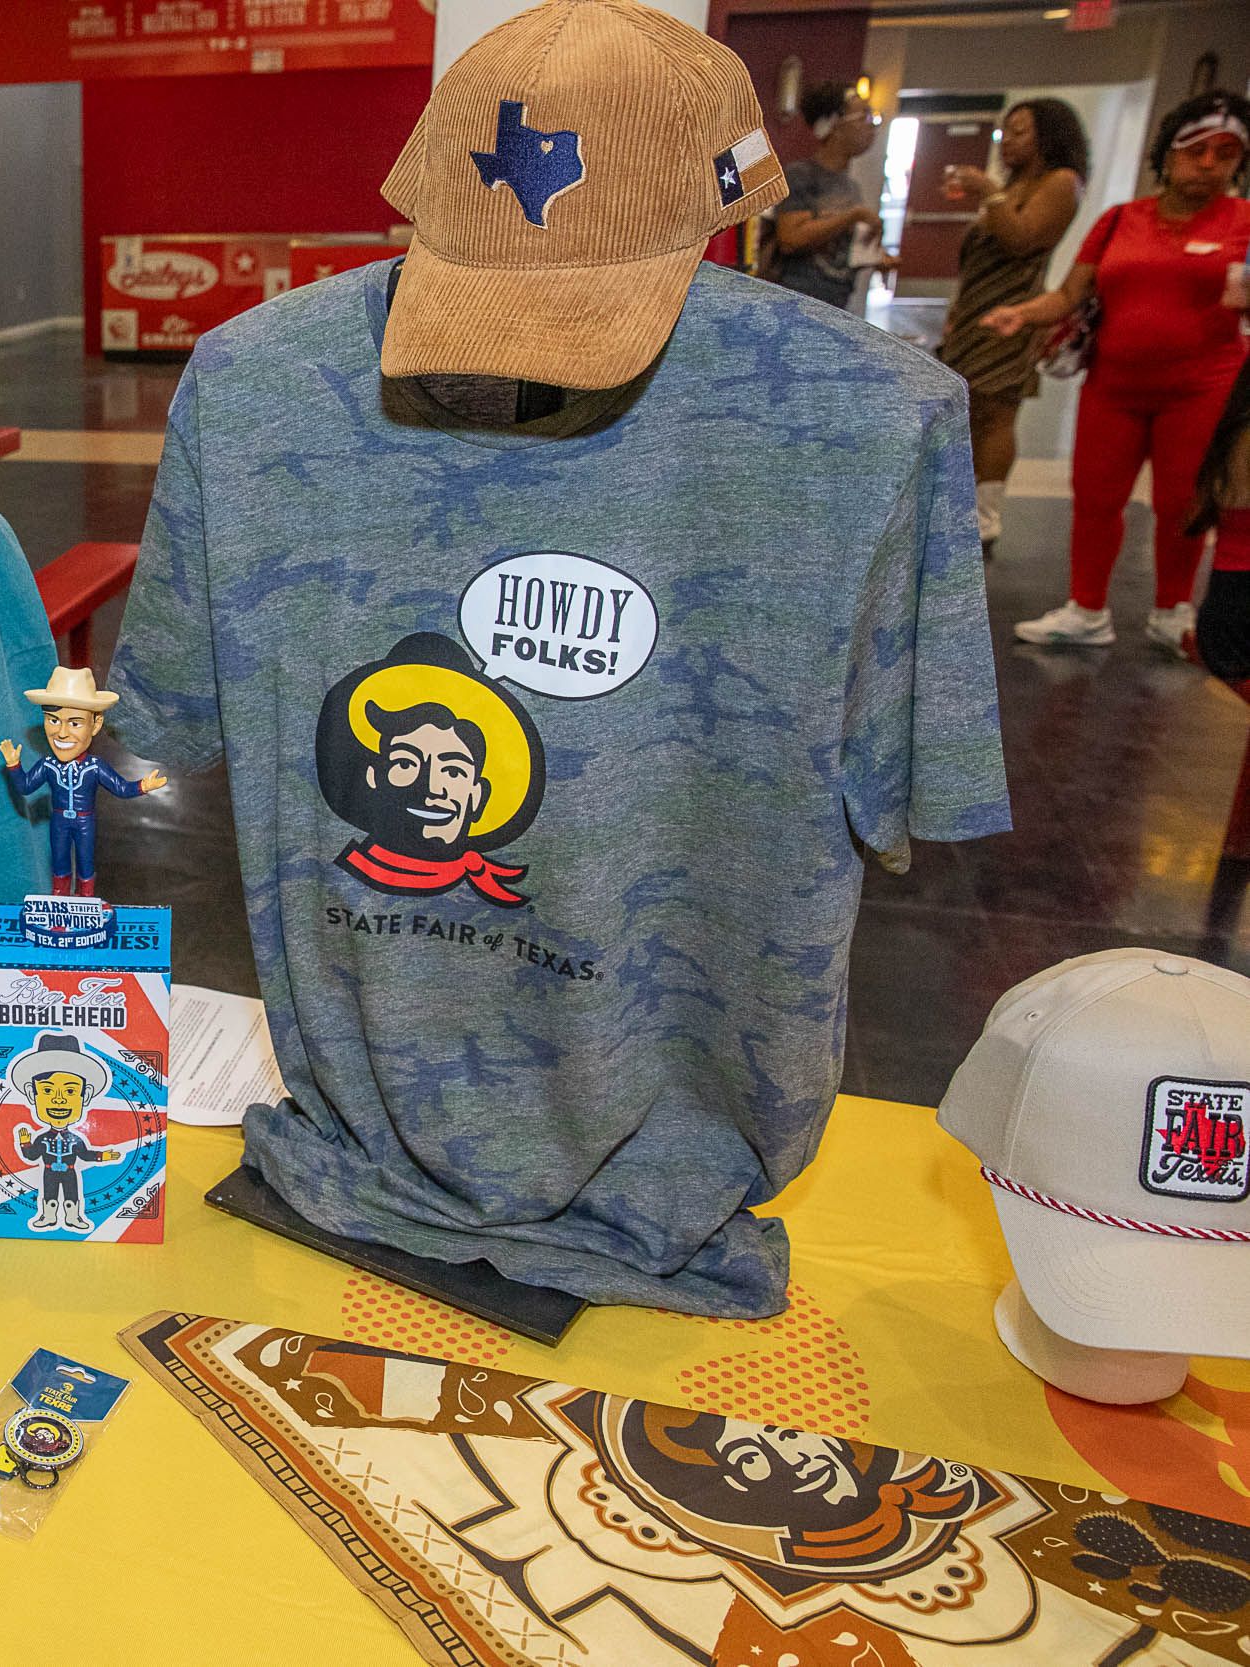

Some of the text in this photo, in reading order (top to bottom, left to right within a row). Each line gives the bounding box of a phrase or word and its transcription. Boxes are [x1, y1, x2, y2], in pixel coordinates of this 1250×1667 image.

[495, 573, 634, 643] HOWDY
[491, 632, 618, 676] FOLKS!
[48, 913, 102, 929] HOWDIES!
[326, 907, 402, 934] STATE
[411, 915, 477, 945] FAIR
[483, 932, 504, 951] of
[75, 930, 107, 947] EDITION
[70, 977, 125, 1006] Tex
[1167, 1090, 1243, 1111] STATE
[1161, 1107, 1245, 1158] FAIR
[39, 1393, 73, 1413] TEXAS
[44, 1386, 64, 1397] STATE
